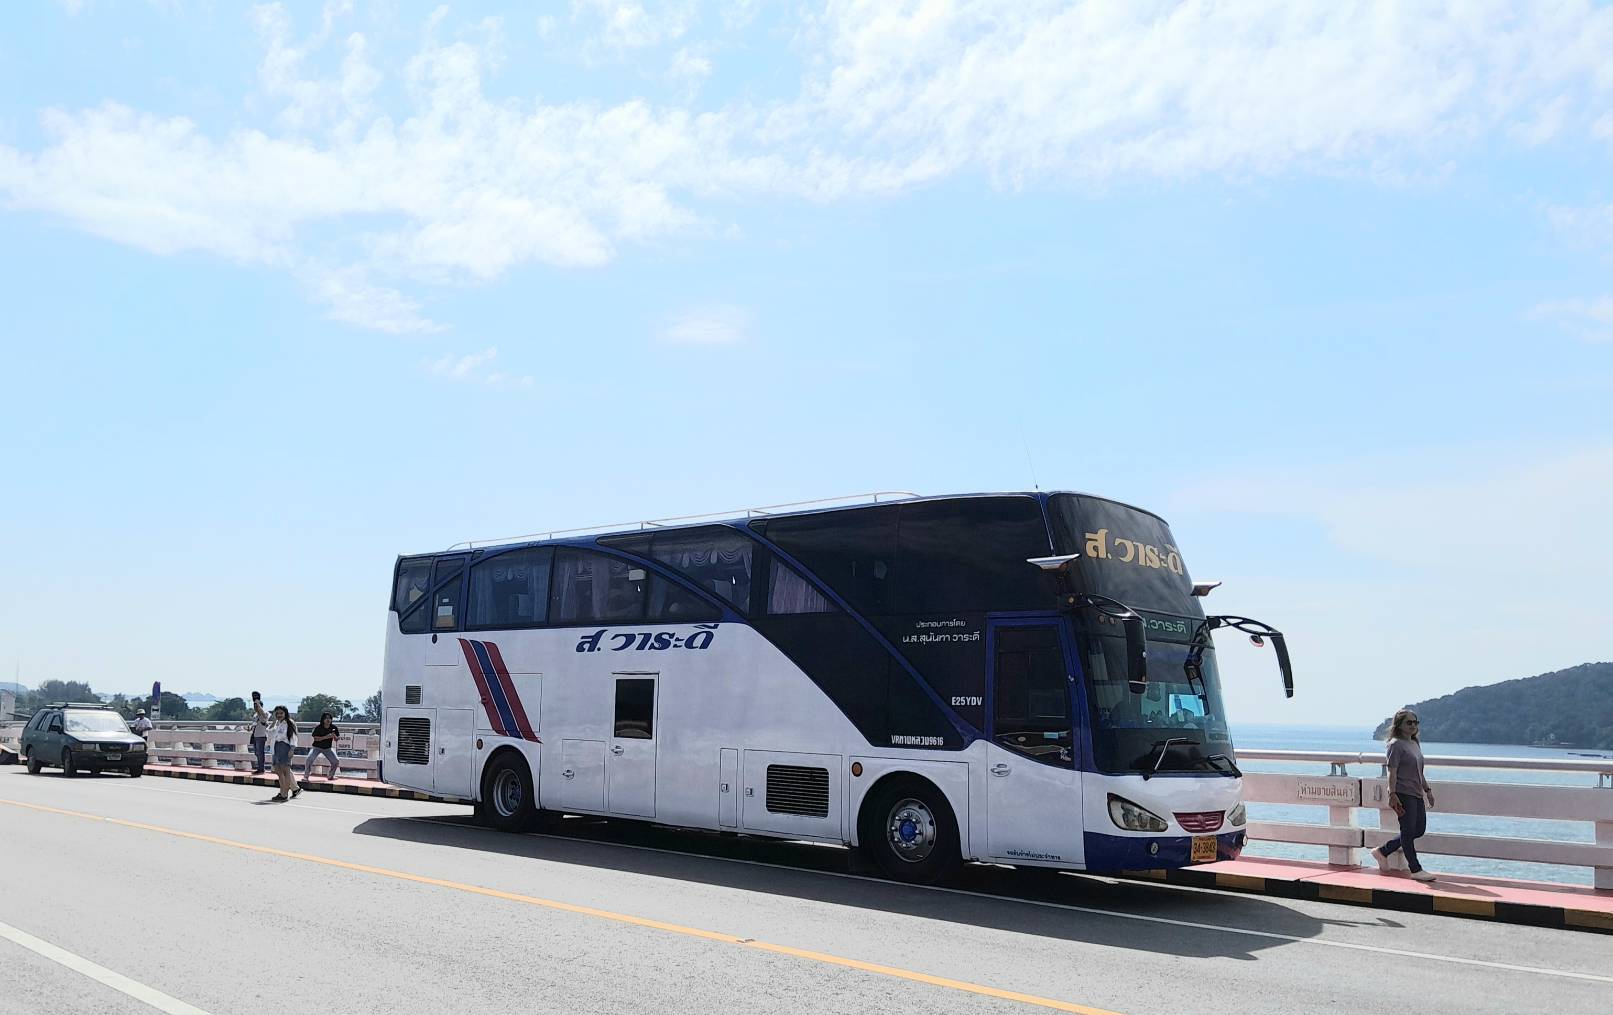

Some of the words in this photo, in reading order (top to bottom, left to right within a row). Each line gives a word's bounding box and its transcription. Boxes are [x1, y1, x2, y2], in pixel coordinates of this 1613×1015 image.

[1085, 529, 1112, 559] ส.
[1114, 538, 1184, 576] วาระดี
[916, 618, 966, 628] ประกอบการโดย
[575, 629, 608, 653] ส.
[610, 623, 720, 652] วาระดี
[952, 630, 980, 642] วาระดี
[951, 696, 983, 706] E25YDV
